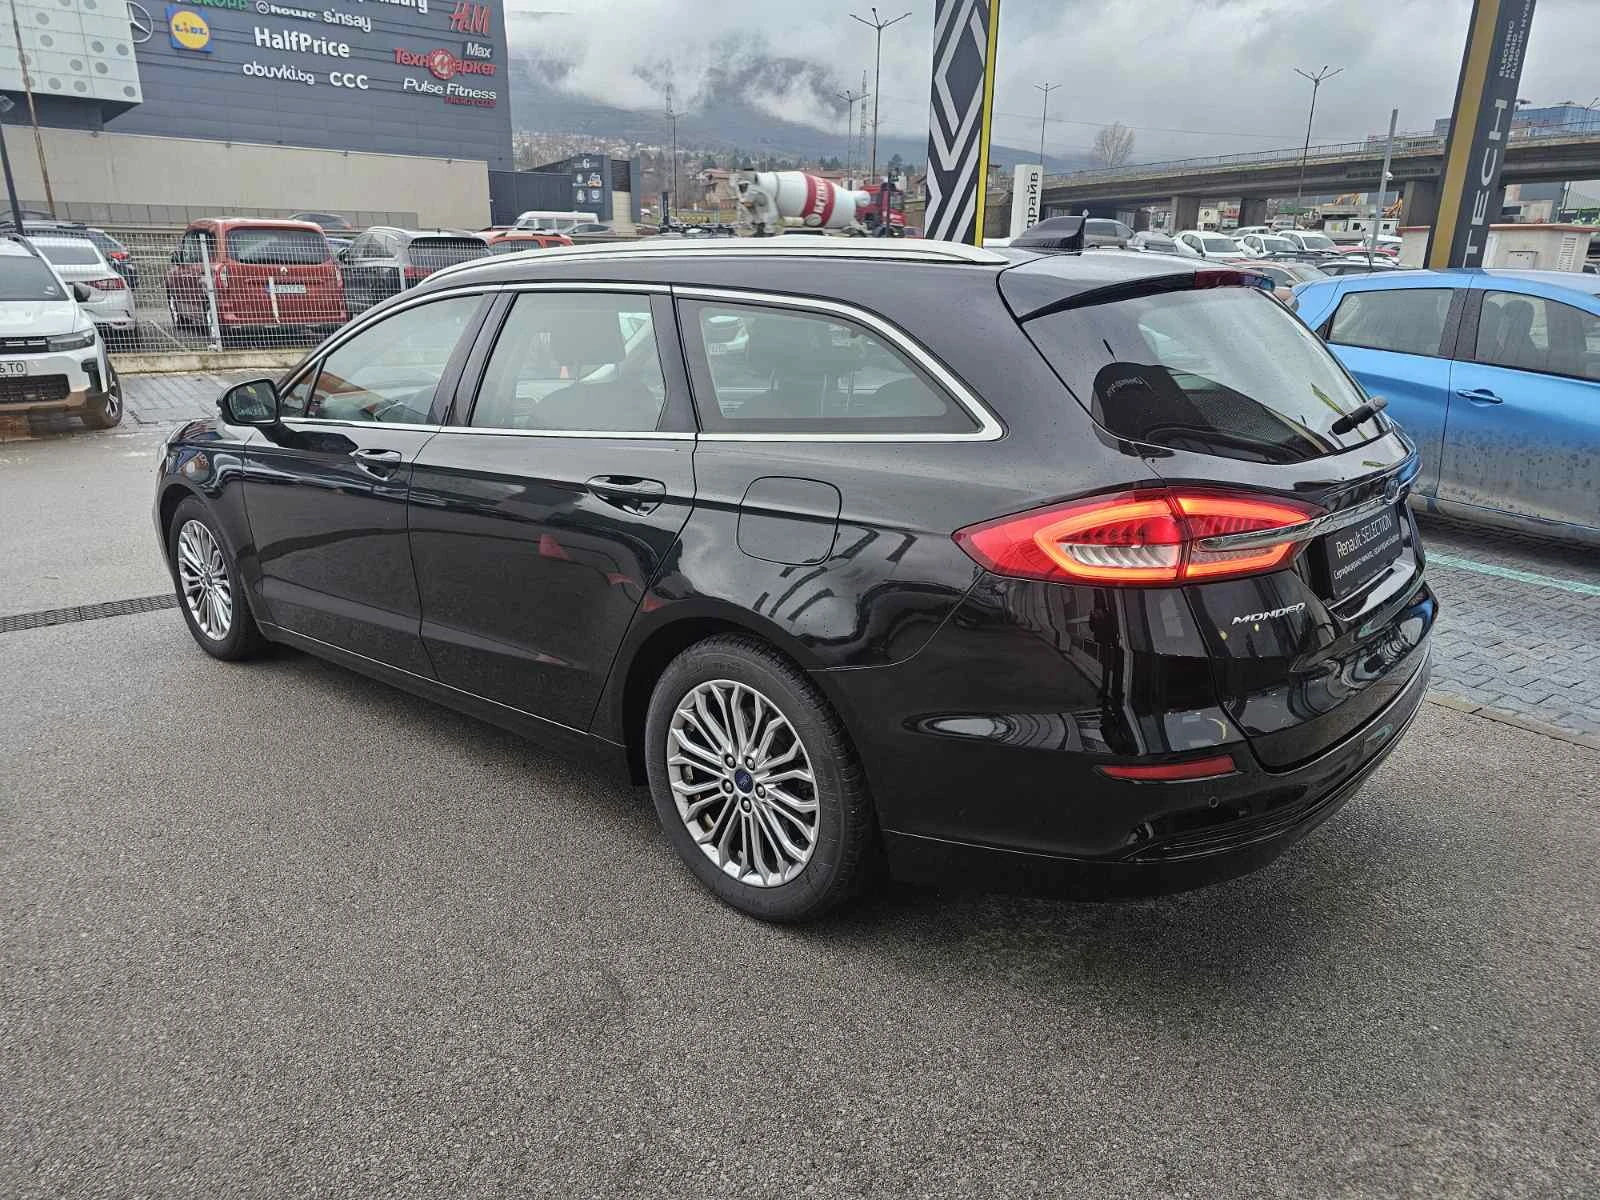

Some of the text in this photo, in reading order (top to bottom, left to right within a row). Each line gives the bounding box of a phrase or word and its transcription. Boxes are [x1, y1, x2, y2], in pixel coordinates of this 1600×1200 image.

[323, 8, 372, 33] sinsay
[449, 1, 489, 34] H&M
[253, 26, 351, 58] HalfPrice
[465, 42, 493, 59] Max
[242, 60, 316, 86] obuvki.bg
[329, 71, 370, 90] CCC
[402, 77, 498, 100] Pulse Fitness
[1462, 98, 1508, 269] TECH
[1335, 530, 1363, 559] Renault
[1360, 511, 1393, 544] SELECTION
[1231, 602, 1306, 625] MONDEO
